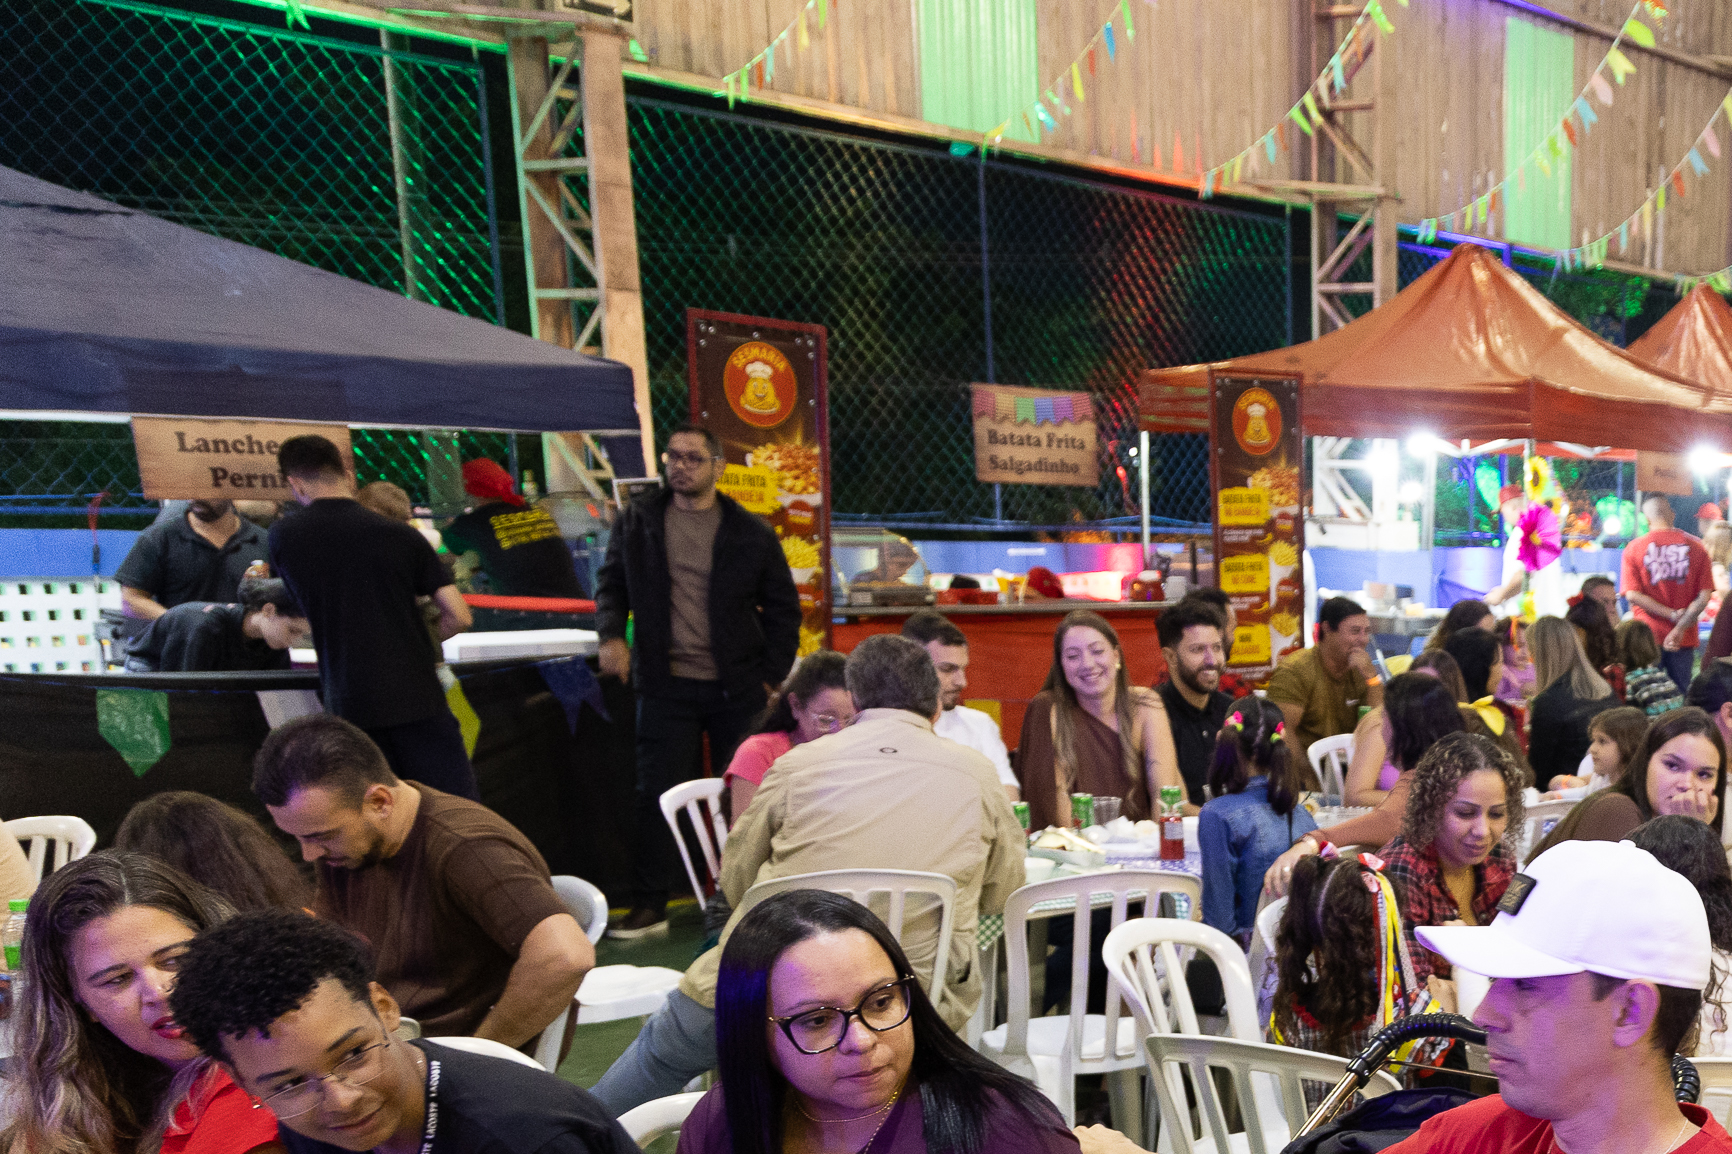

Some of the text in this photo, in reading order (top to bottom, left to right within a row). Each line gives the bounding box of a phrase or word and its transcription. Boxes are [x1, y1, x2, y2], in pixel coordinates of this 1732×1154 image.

[988, 428, 1085, 450] Batata Frita
[989, 454, 1079, 475] Salgadinho
[1643, 541, 1691, 566] JUST
[425, 1101, 439, 1139] LACOSTE
